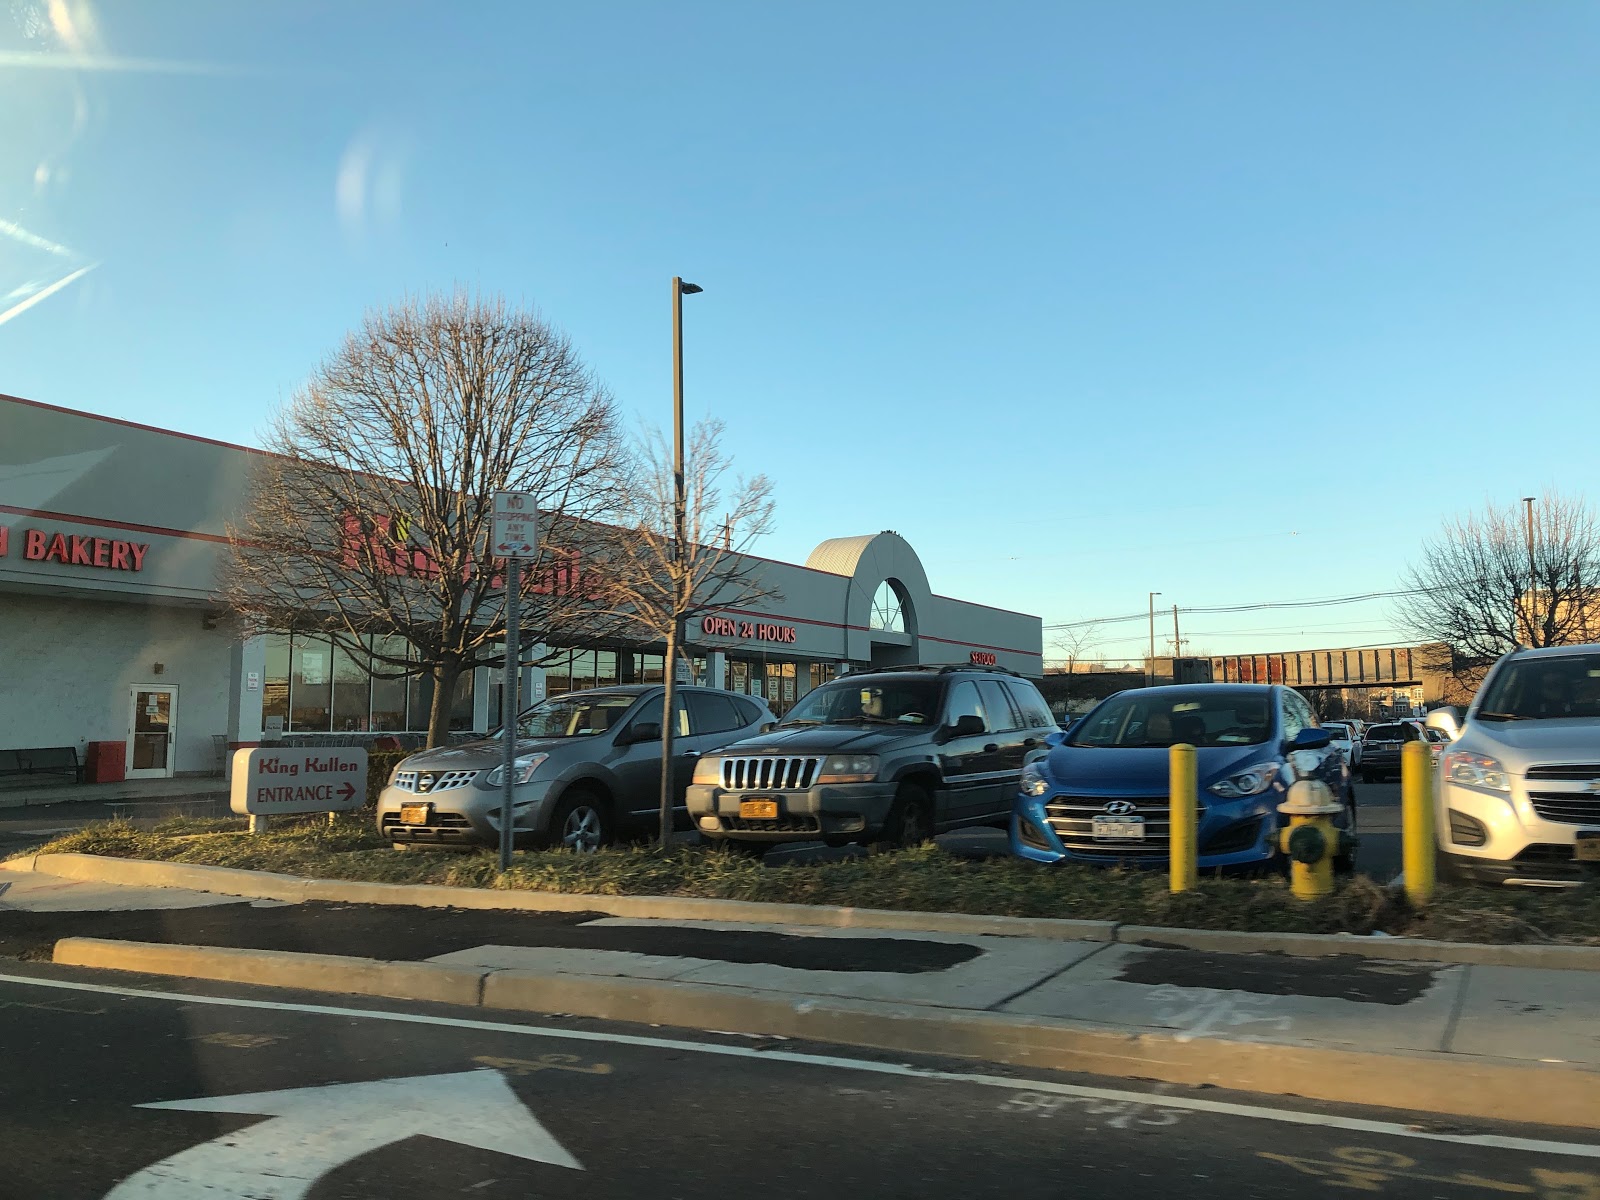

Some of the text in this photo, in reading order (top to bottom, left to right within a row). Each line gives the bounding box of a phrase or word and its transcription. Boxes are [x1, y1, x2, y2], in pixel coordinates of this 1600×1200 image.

[507, 496, 524, 509] NO
[504, 532, 526, 541] TIME
[506, 523, 525, 532] ANY
[24, 528, 150, 571] BAKERY
[703, 616, 796, 643] OPEN 24 HOURS
[258, 757, 358, 776] King Kullen
[257, 785, 334, 803] ENTRANCE
